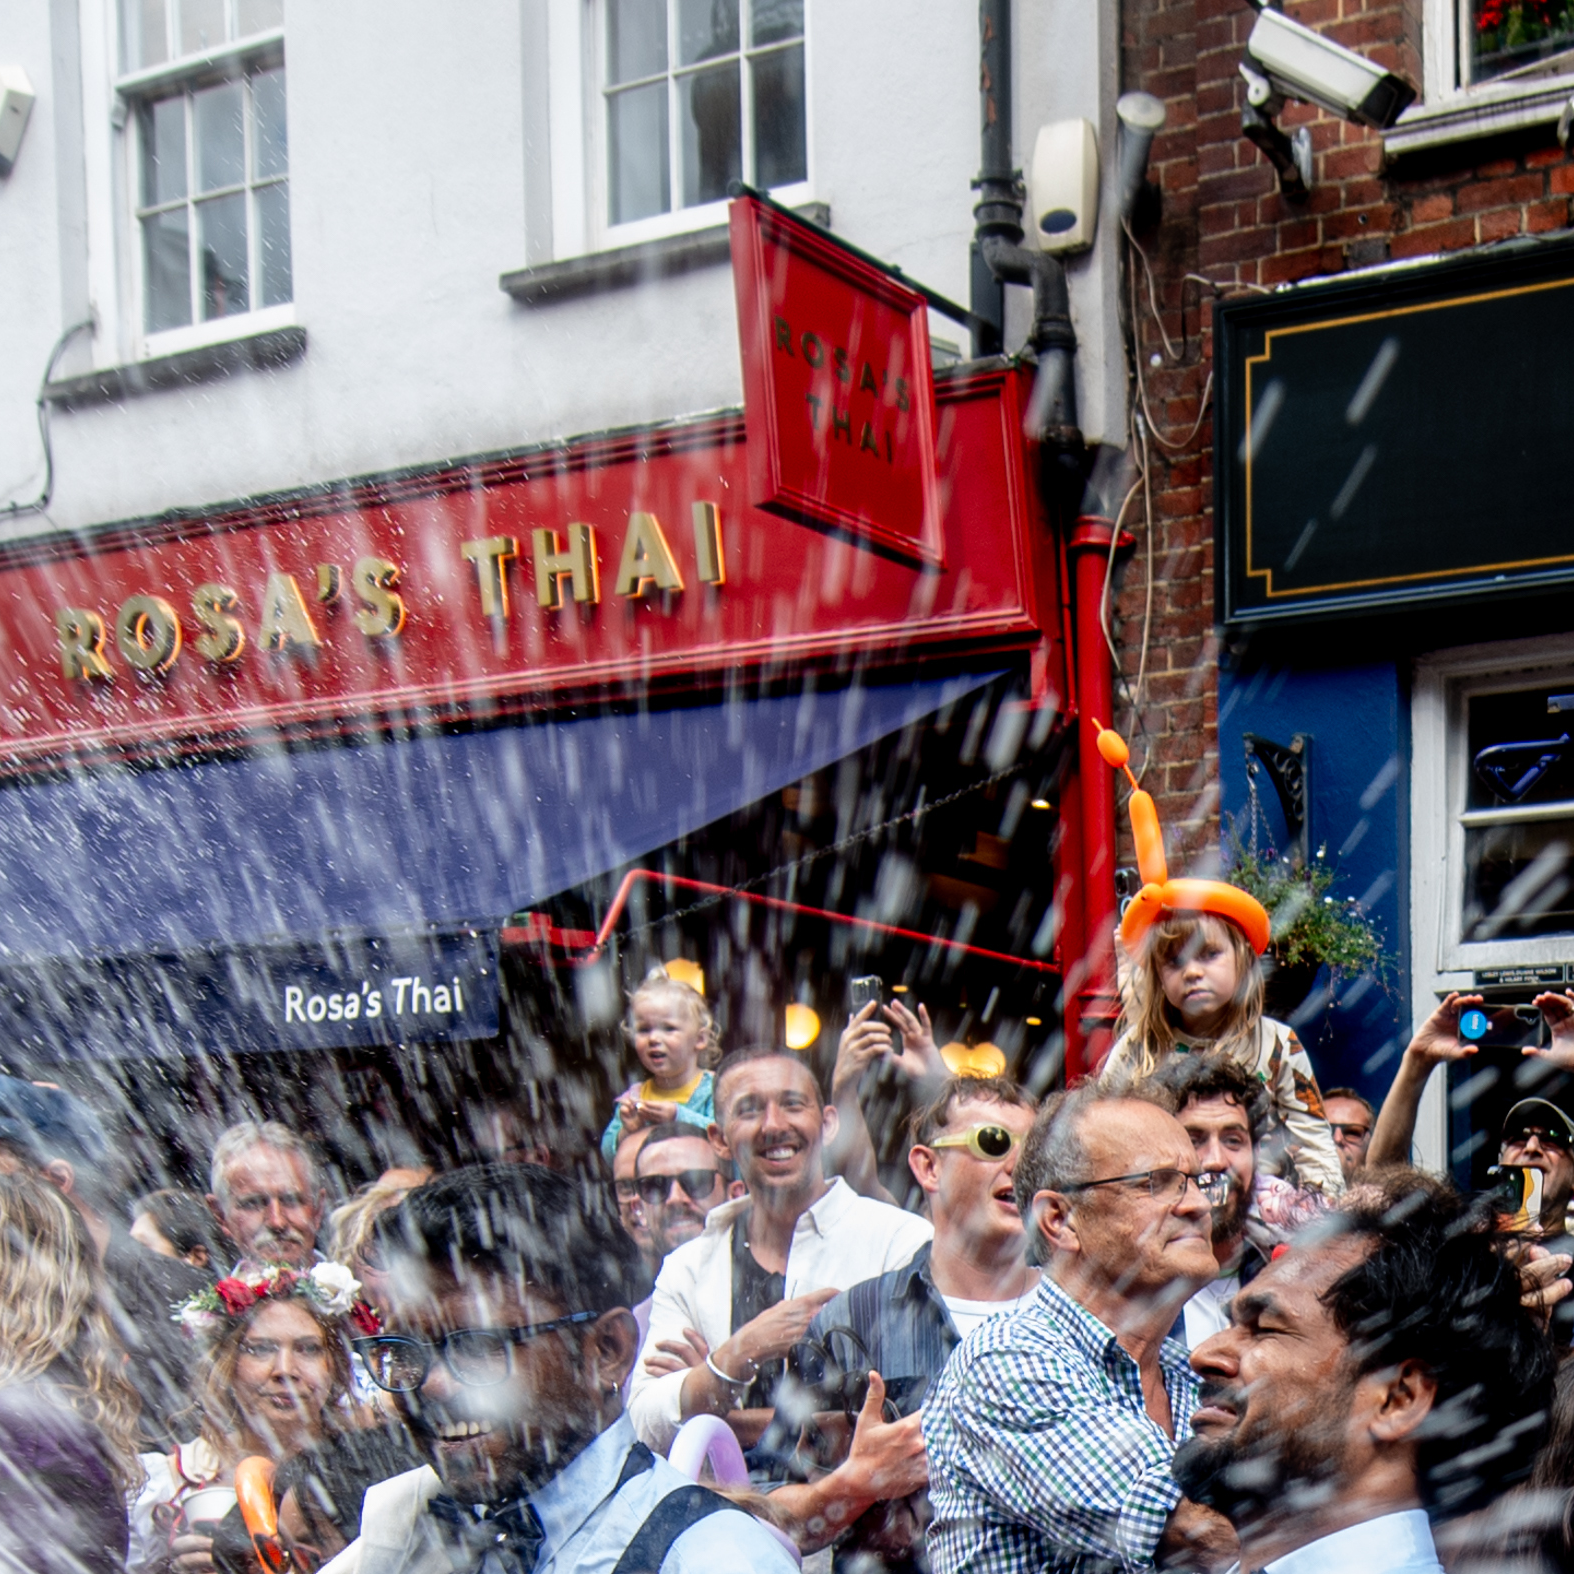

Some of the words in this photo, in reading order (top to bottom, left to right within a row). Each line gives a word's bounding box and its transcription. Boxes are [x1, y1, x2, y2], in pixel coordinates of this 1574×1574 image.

[775, 314, 911, 412] ROSA'S
[805, 392, 893, 465] THAI
[55, 556, 407, 680] ROSA'S
[461, 500, 726, 618] THAI
[285, 981, 382, 1023] Rosa's
[391, 976, 464, 1015] Thai
